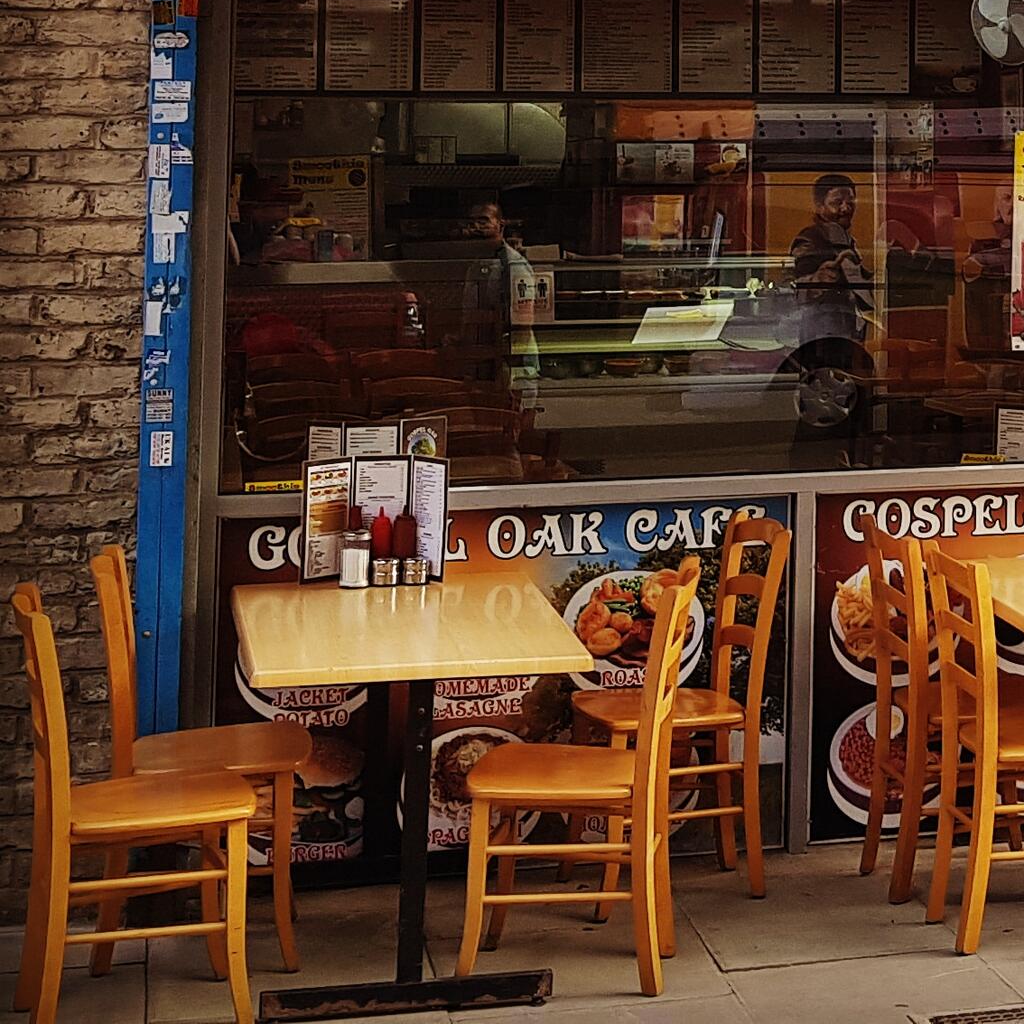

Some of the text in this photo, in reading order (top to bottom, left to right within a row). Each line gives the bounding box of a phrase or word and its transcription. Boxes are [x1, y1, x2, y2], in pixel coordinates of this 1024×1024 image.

[488, 512, 608, 558] OAK
[434, 677, 530, 696] OMEMADE
[272, 687, 350, 707] JACKET
